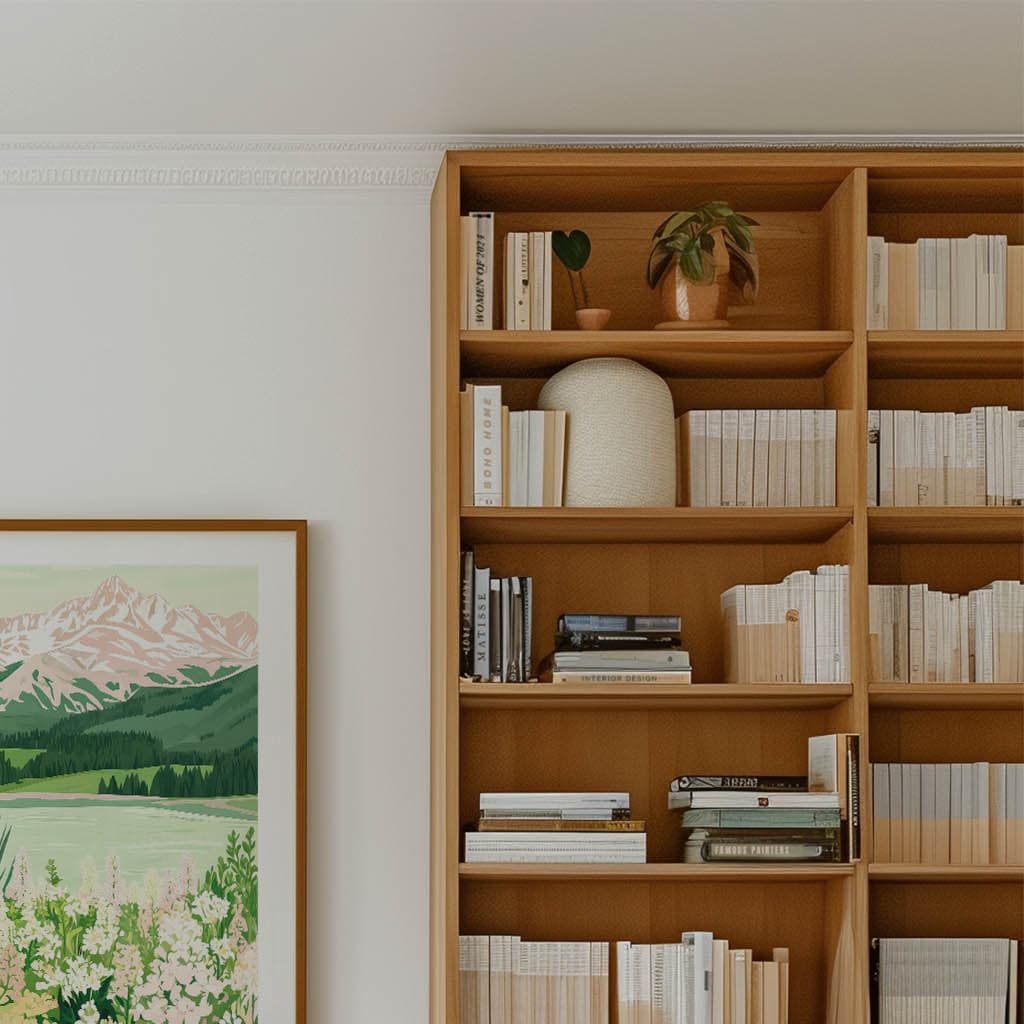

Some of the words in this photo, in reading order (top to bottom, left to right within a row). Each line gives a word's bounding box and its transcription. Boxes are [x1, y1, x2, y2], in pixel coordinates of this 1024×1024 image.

[476, 261, 485, 275] OF
[476, 278, 485, 323] WOMEN
[483, 398, 492, 440] HOME
[483, 447, 492, 489] BOHO
[477, 593, 487, 662] MATISSE
